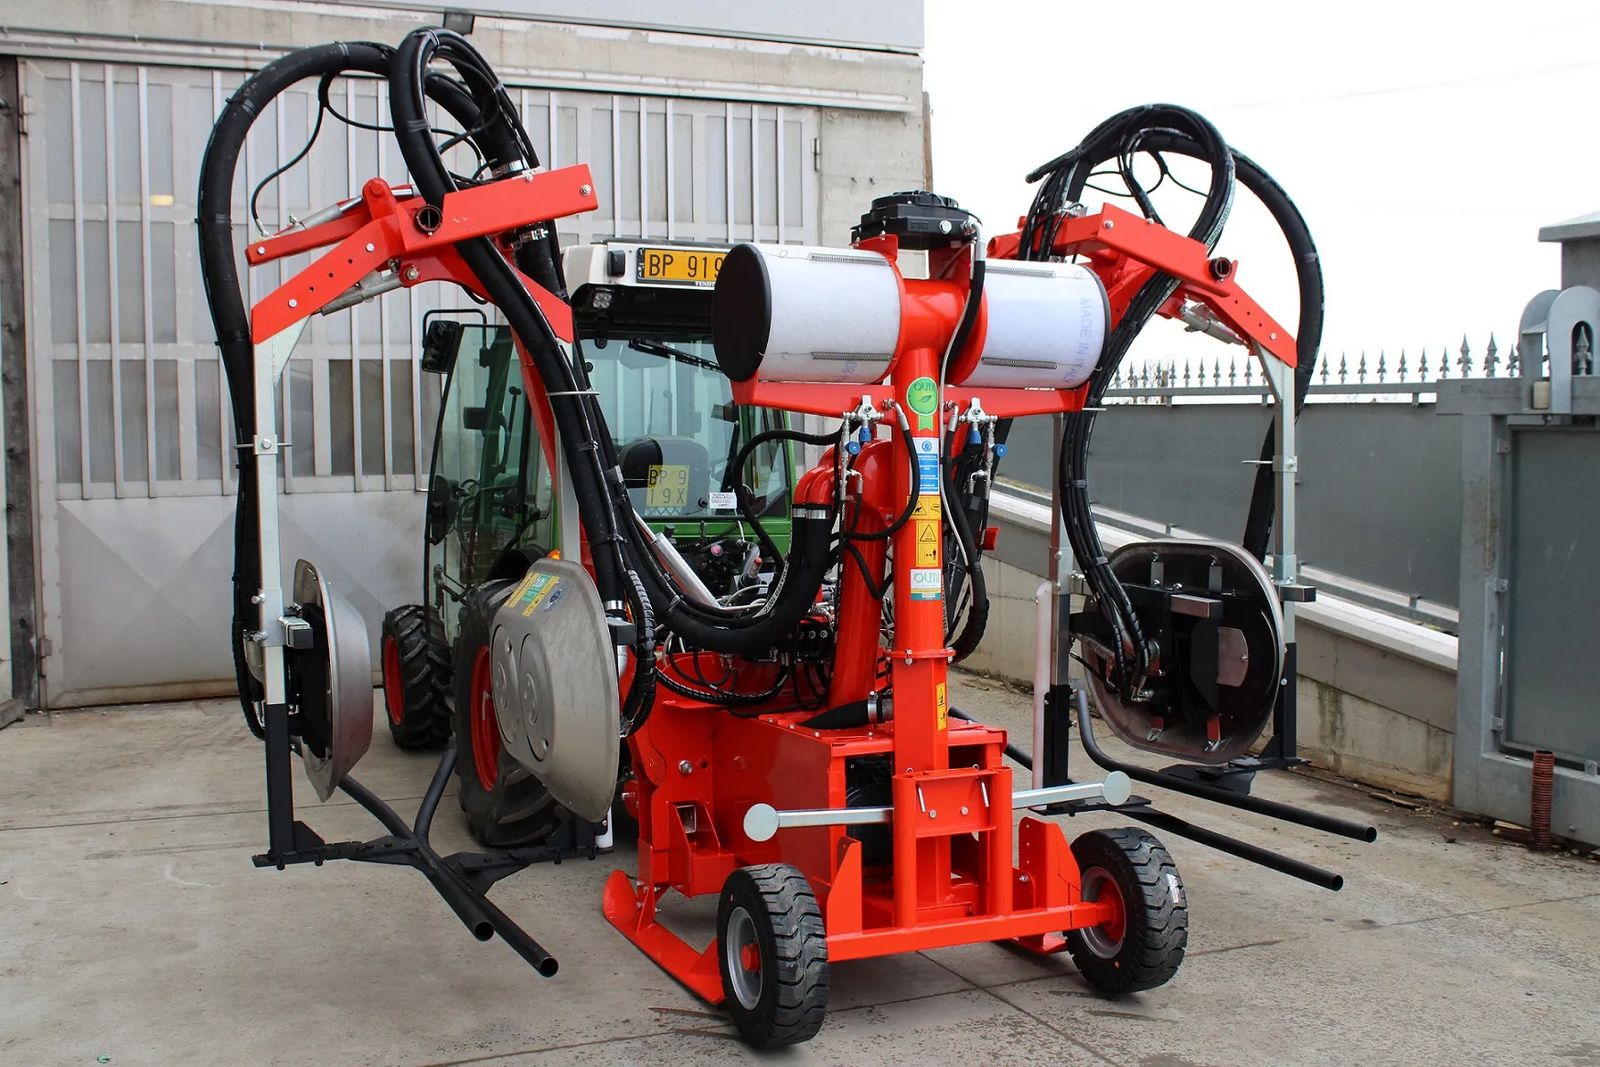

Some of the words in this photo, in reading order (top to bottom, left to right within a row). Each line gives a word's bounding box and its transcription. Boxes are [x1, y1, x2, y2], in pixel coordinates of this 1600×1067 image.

[649, 254, 674, 276] BP
[1080, 299, 1093, 338] MADE
[649, 469, 668, 485] BP
[679, 469, 687, 486] 9
